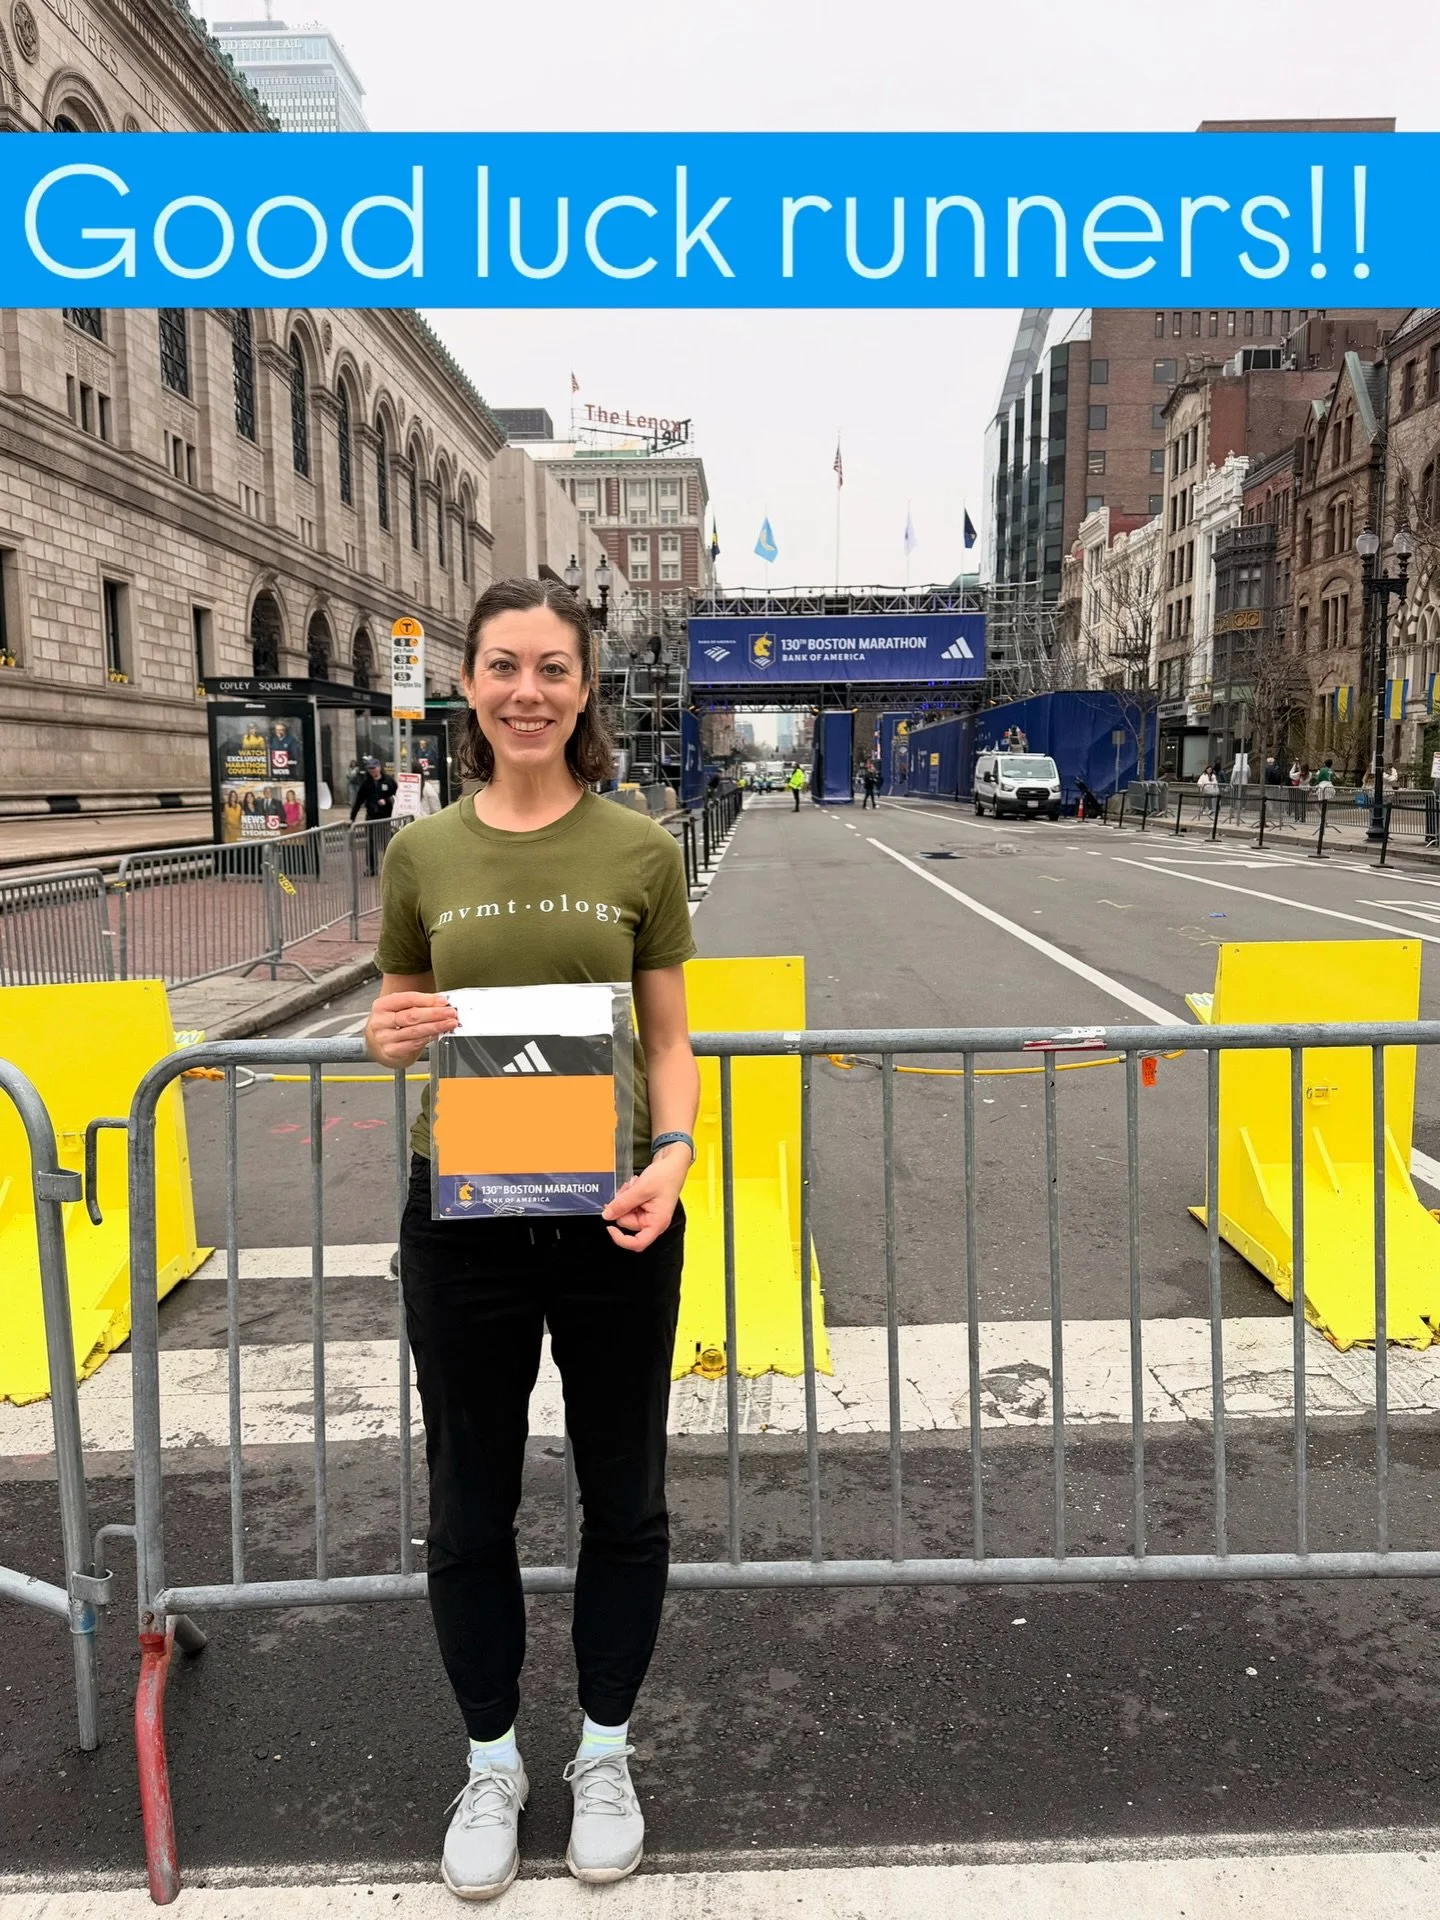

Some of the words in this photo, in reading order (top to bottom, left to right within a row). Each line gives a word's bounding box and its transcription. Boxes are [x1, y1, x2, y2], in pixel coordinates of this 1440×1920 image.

[45, 0, 118, 76] QUIRES
[584, 404, 620, 425] The
[626, 410, 681, 433] Lenox
[402, 623, 412, 632] T
[808, 638, 855, 650] BOSTON
[859, 637, 927, 649] MARATHON
[782, 654, 807, 662] BANK
[809, 653, 821, 661] OF
[823, 653, 865, 661] AMERICA
[259, 682, 292, 691] SQUARE
[241, 815, 265, 823] NEWS
[504, 1185, 541, 1194] BOSTON
[545, 1183, 599, 1193] MARATHON
